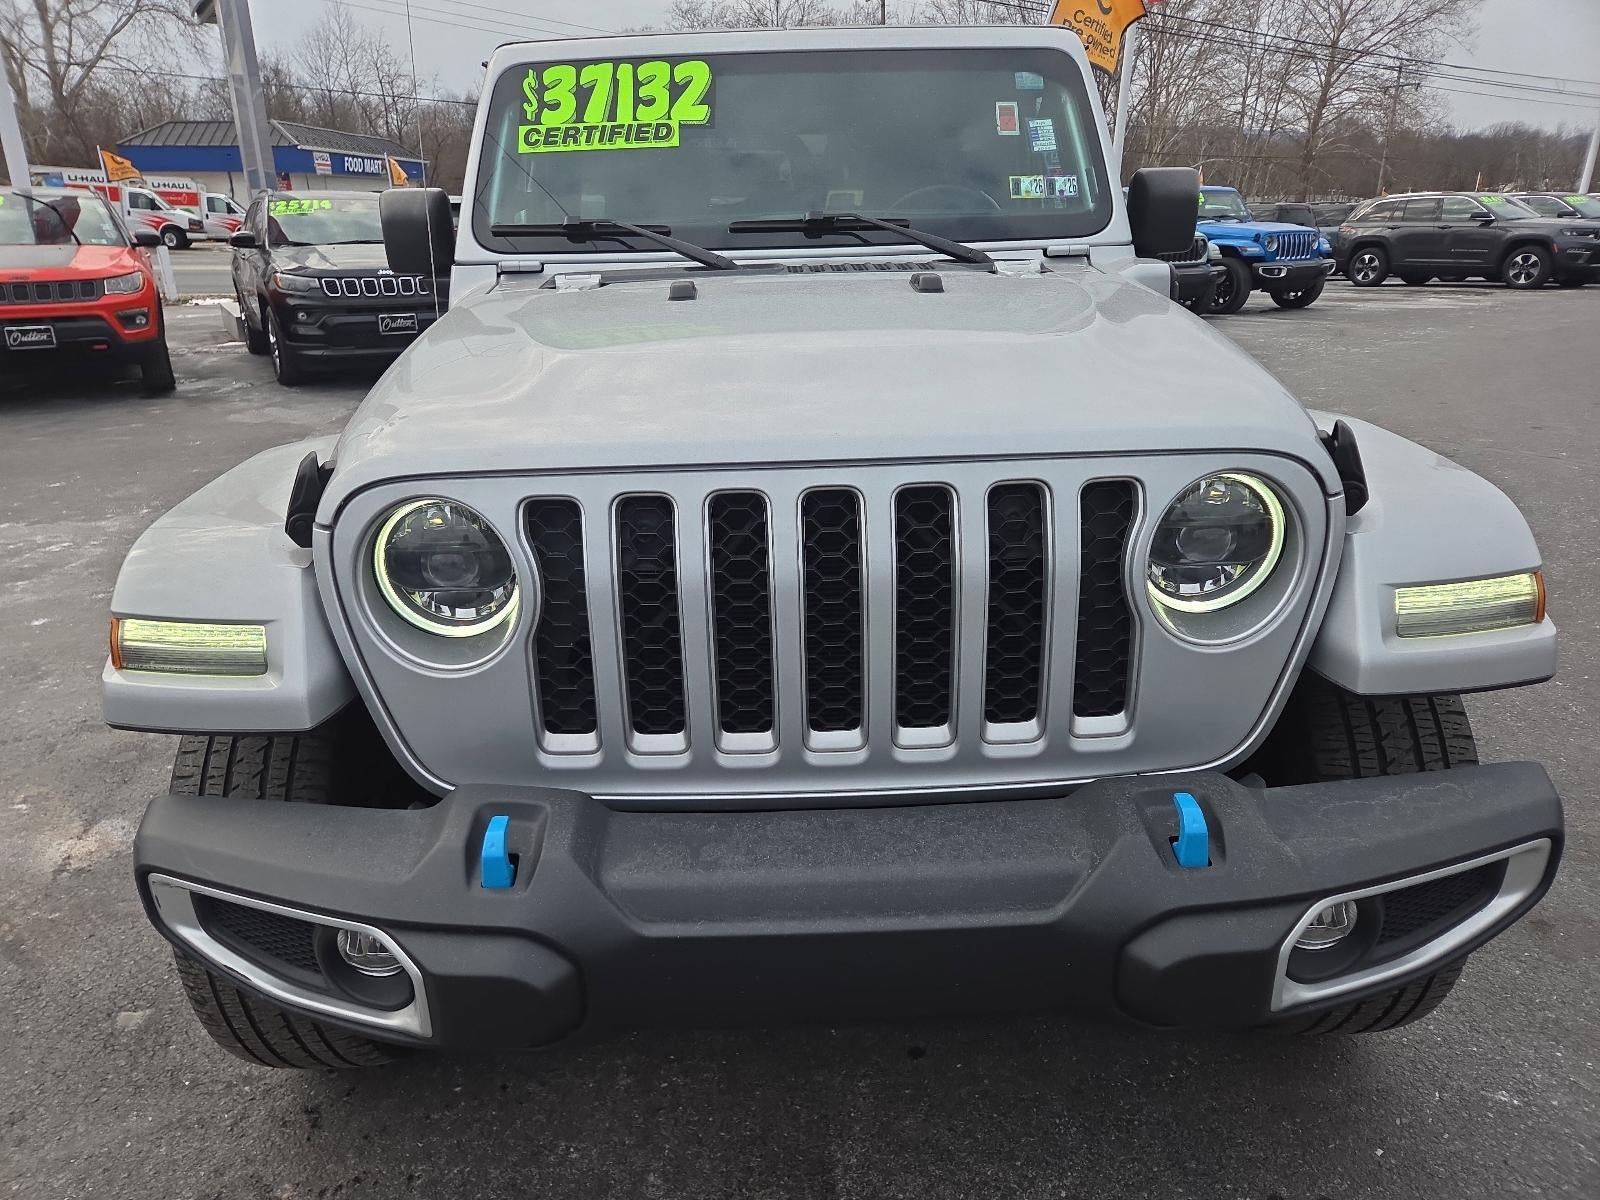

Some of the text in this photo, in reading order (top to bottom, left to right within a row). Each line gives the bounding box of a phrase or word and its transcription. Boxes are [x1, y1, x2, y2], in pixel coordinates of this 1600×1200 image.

[1073, 9, 1113, 44] Certified
[522, 60, 713, 126] $37132
[523, 122, 675, 148] CERTIFIED
[344, 156, 383, 174] FOOD MART
[67, 174, 106, 183] U-HAU
[151, 181, 192, 190] U-HAUL
[1034, 178, 1044, 194] 26
[1067, 178, 1077, 194] 26
